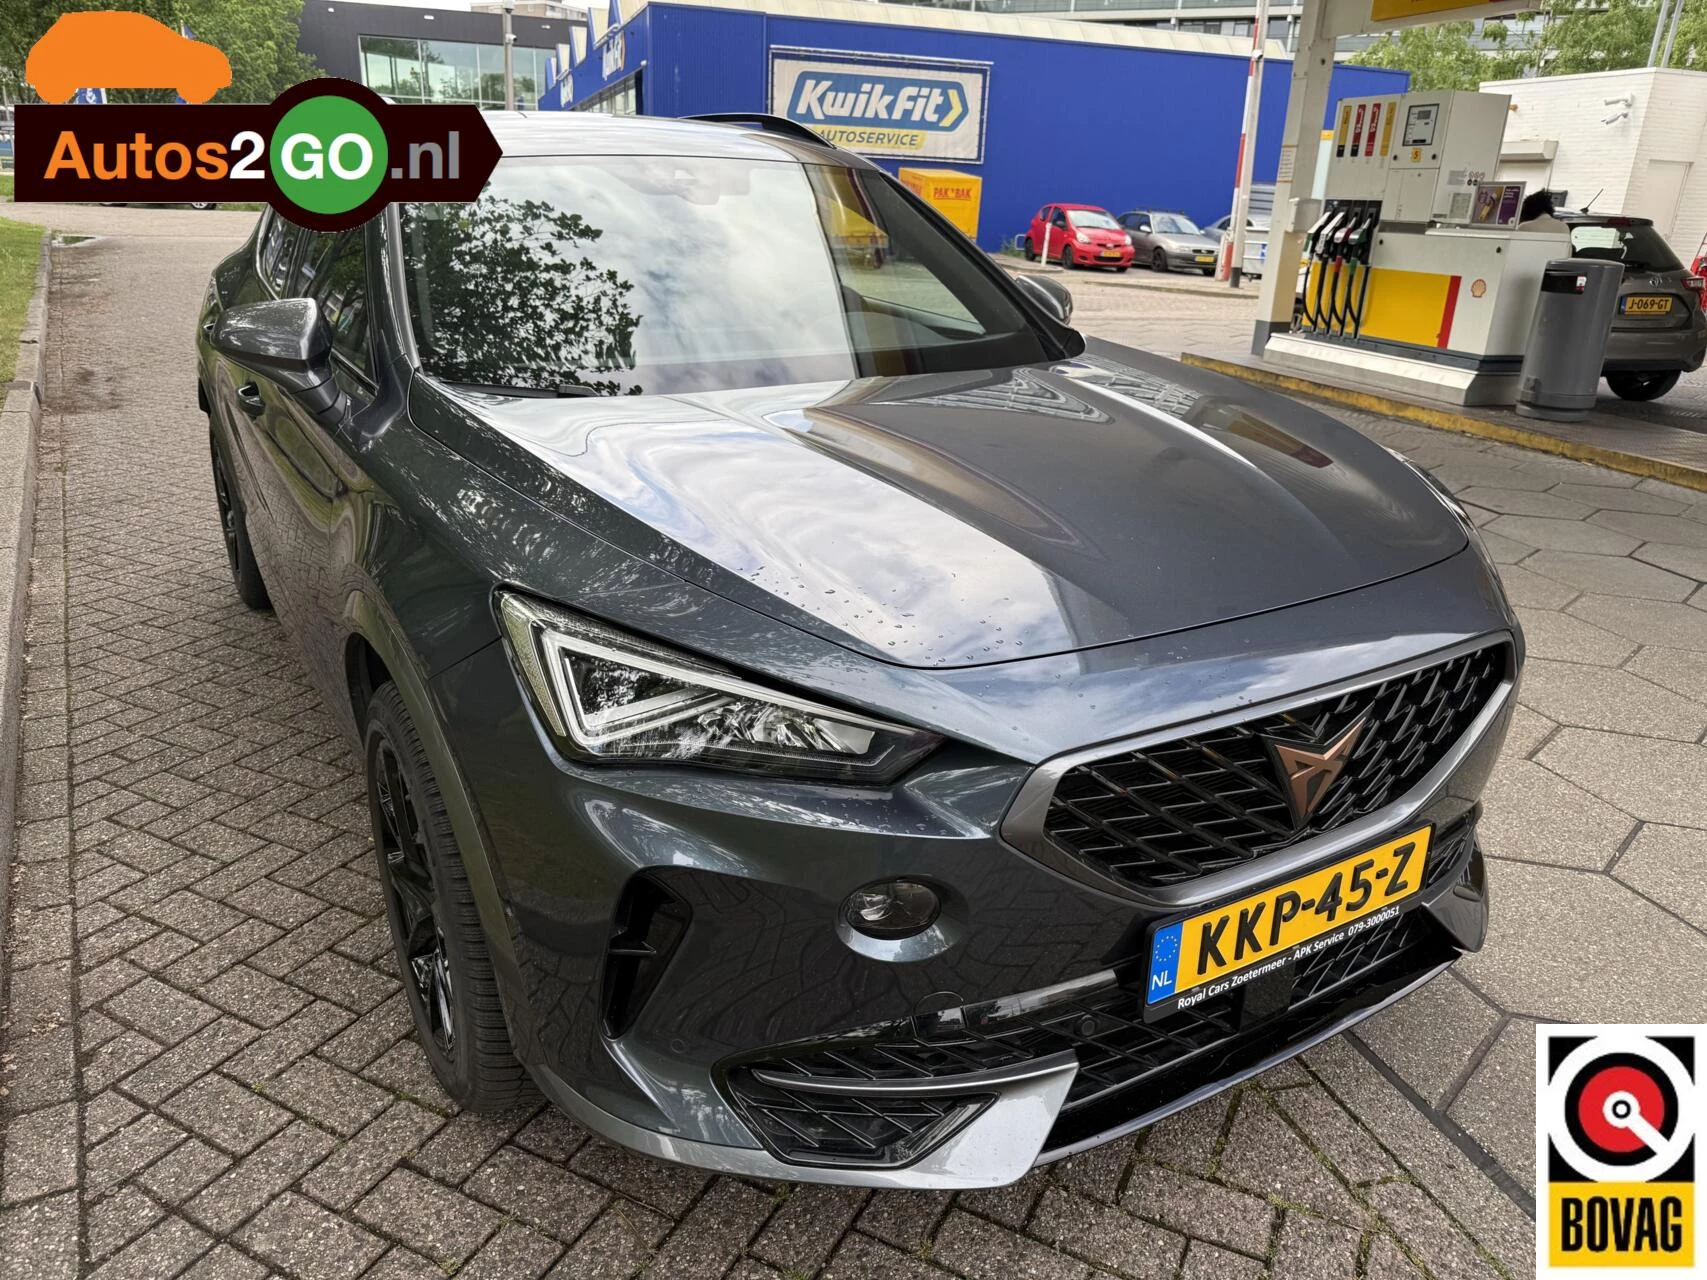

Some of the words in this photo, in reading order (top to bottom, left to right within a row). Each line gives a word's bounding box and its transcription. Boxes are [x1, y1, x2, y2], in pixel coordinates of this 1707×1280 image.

[1628, 298, 1670, 310] J-069-GT
[1197, 841, 1416, 975] KKP-45-Z
[1151, 970, 1172, 990] NL
[1177, 989, 1206, 1010] Royal
[1208, 981, 1230, 996] Cars
[1231, 956, 1287, 987] Zoetermeer
[1293, 945, 1312, 960] APK
[1313, 932, 1345, 953] Service
[1347, 905, 1400, 937] 079-3000051
